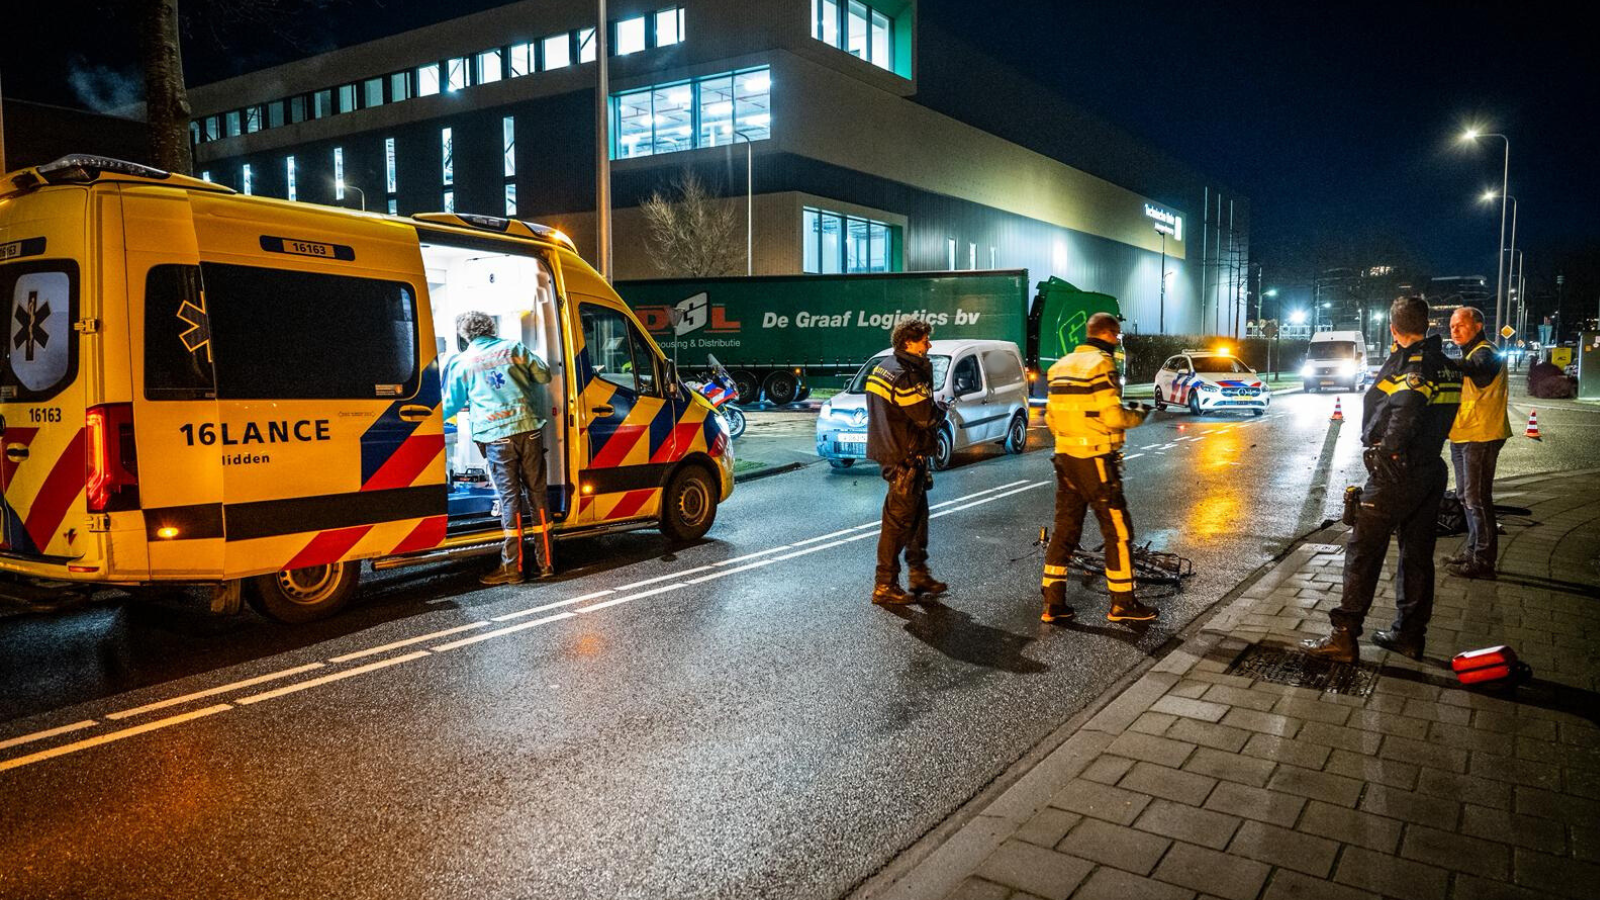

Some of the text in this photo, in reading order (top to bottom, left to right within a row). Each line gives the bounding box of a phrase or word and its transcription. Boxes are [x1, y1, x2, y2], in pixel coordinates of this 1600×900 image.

[293, 242, 326, 255] 16163
[762, 308, 980, 330] De Graaf Logistics bv
[689, 339, 696, 347] &
[698, 338, 741, 348] Distributie
[29, 408, 61, 422] 16163
[222, 454, 270, 466] idden
